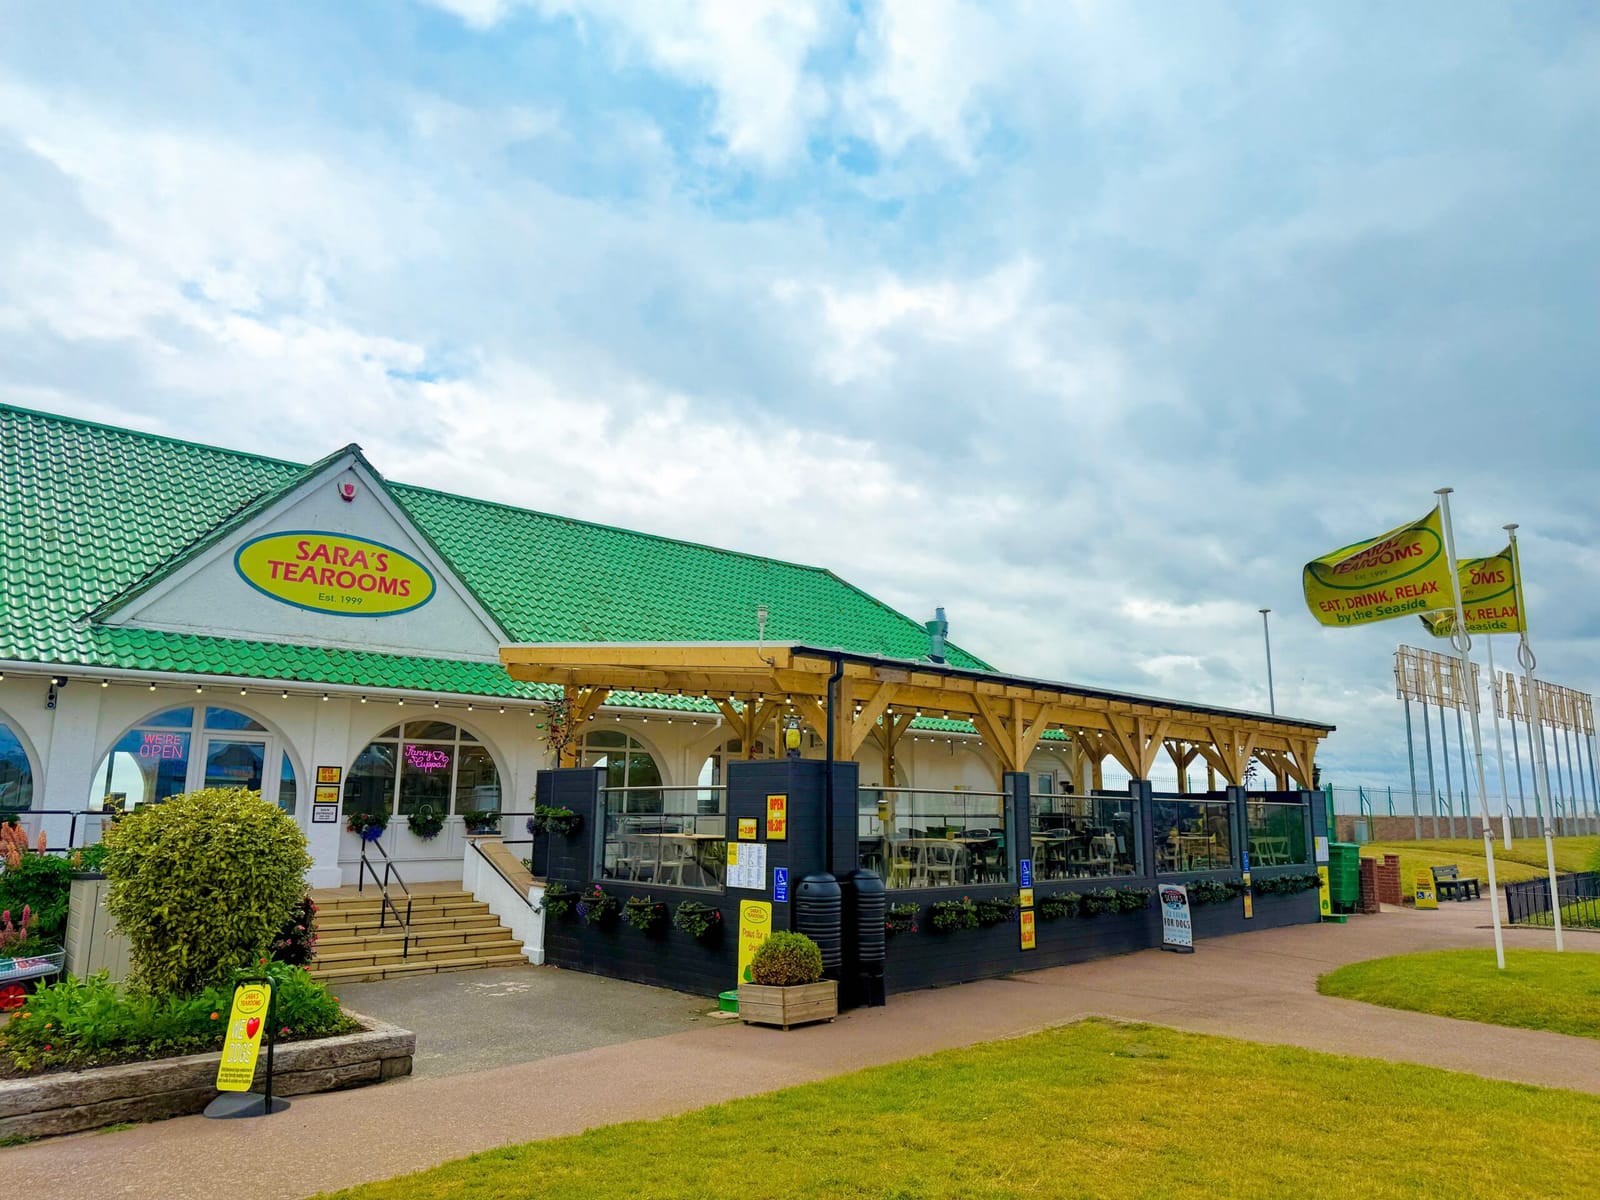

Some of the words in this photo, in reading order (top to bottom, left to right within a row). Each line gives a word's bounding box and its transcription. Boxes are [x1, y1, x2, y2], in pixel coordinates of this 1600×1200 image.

[295, 541, 388, 572] SARA'S
[267, 560, 411, 597] TEAROOMS
[318, 592, 337, 602] Est.
[341, 593, 363, 605] 1999
[1319, 599, 1345, 613] EAT,
[1348, 590, 1392, 610] DRINK,
[1395, 581, 1439, 597] RELAX
[1336, 612, 1351, 624] by
[1352, 609, 1373, 621] the
[1375, 599, 1426, 616] Seaside
[1477, 606, 1518, 620] RELAX
[144, 734, 181, 745] WE'RE
[140, 744, 183, 758] OPEN
[770, 798, 784, 810] OPEN
[1175, 919, 1191, 929] DOGS
